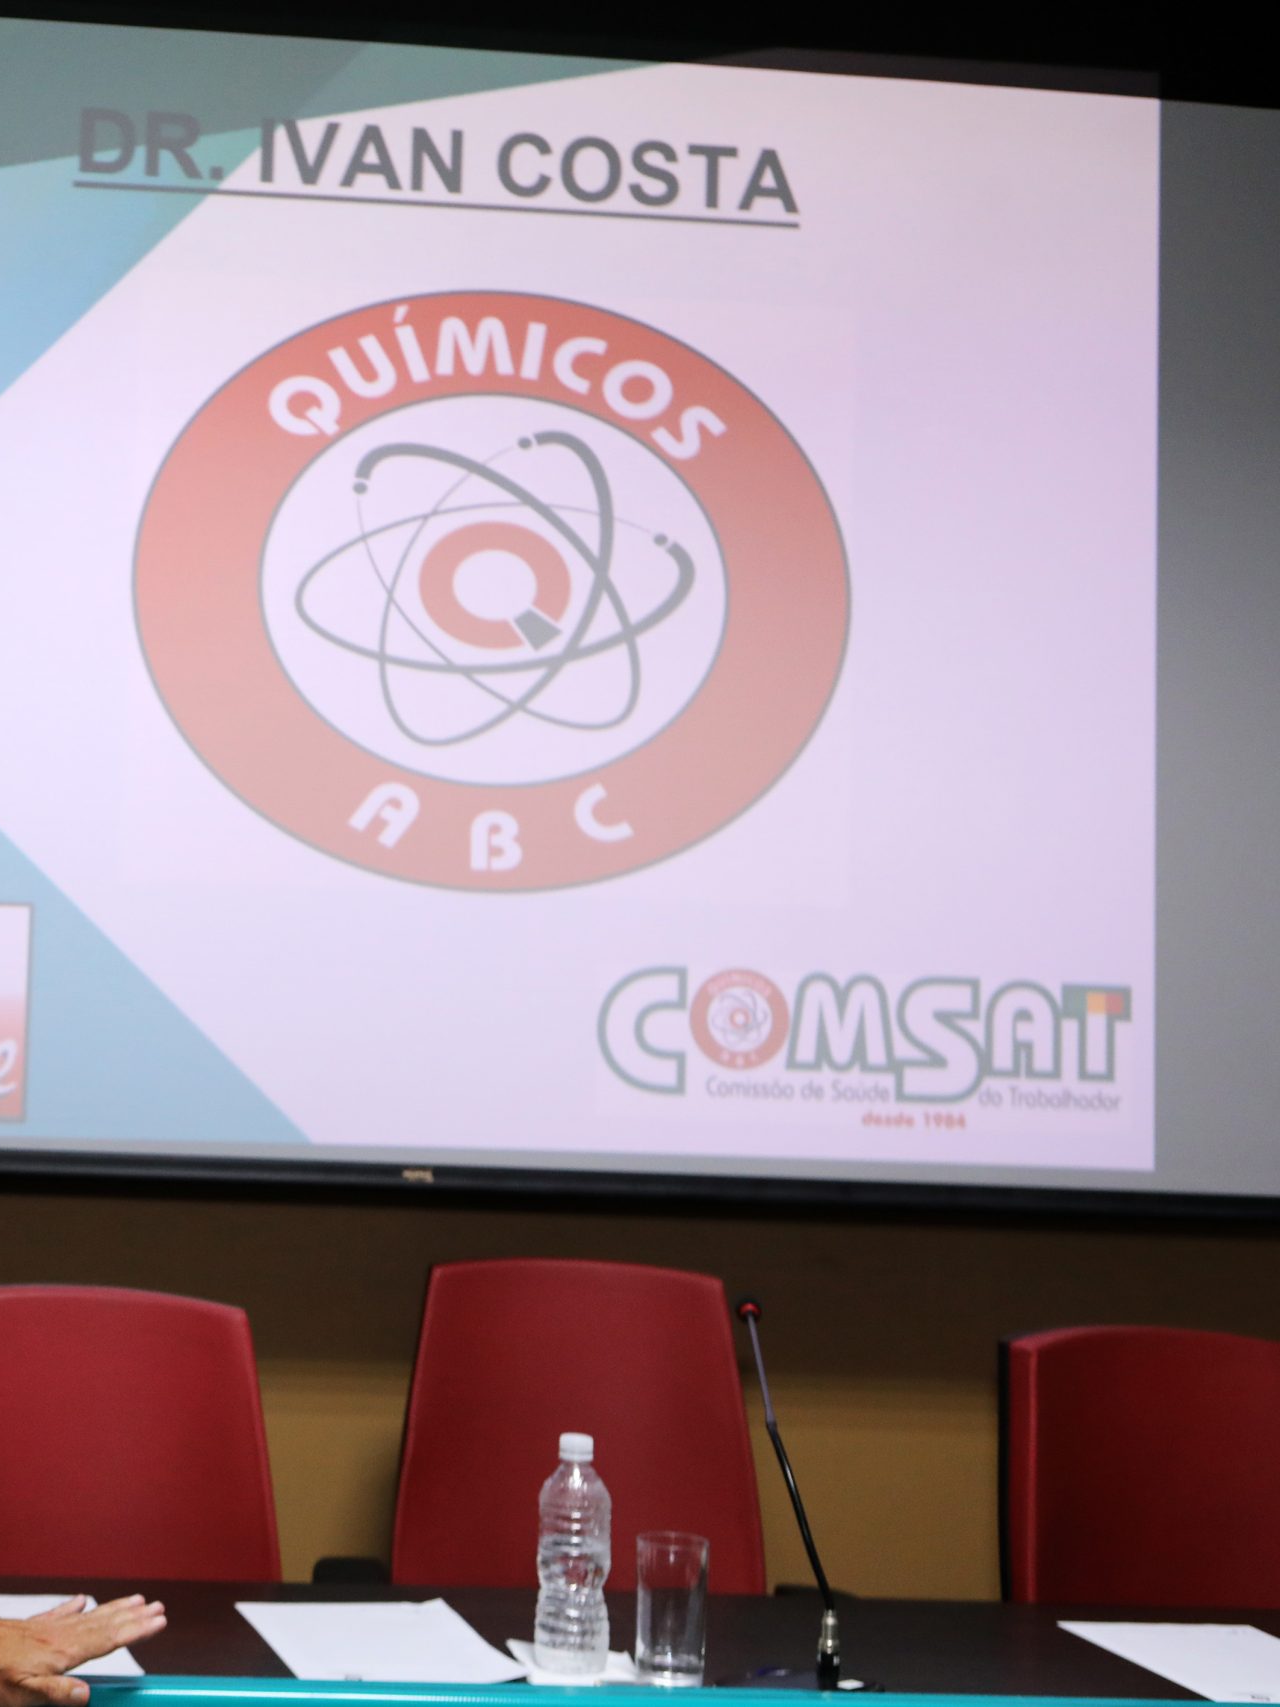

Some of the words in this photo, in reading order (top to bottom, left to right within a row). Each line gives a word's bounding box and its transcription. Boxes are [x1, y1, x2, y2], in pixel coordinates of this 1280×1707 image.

[78, 107, 222, 181] DR.
[259, 118, 464, 195] IVAN
[496, 132, 800, 215] COSTA
[268, 305, 727, 460] QUÍMICOS
[597, 965, 1132, 1104] COMSAT
[705, 1075, 795, 1099] Comissão
[801, 1078, 826, 1100] de
[862, 1111, 915, 1128] desde
